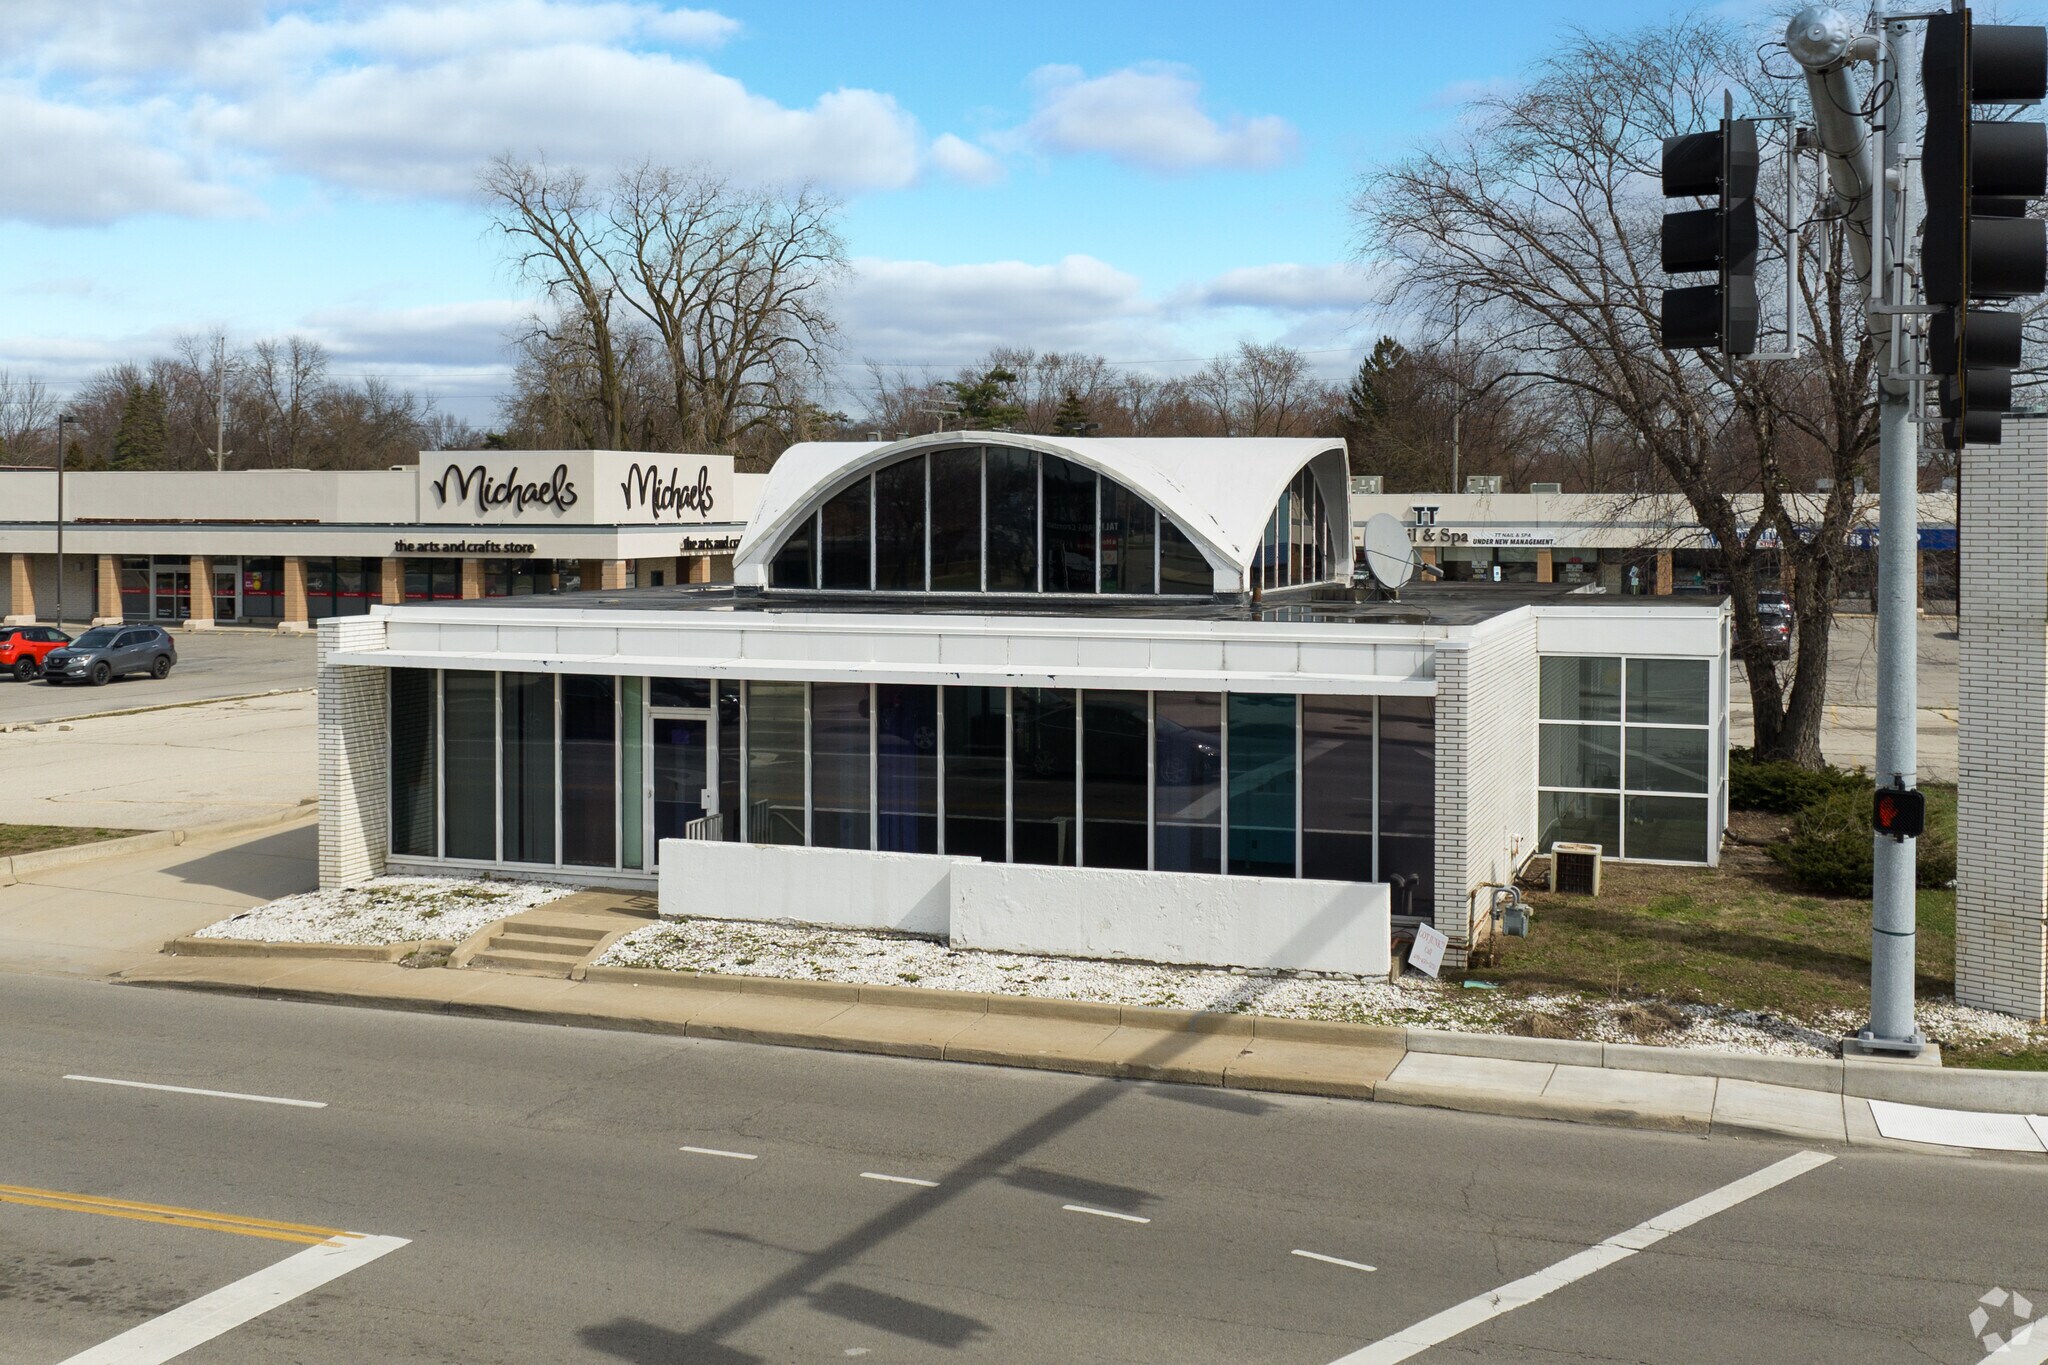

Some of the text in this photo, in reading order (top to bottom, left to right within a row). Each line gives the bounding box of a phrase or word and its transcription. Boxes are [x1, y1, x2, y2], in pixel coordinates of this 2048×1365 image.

[433, 463, 578, 513] Michaels
[620, 463, 714, 519] Michaels
[1411, 505, 1440, 526] TT
[394, 540, 535, 553] the arts and crafts store
[683, 536, 697, 550] the
[698, 538, 713, 550] arts
[714, 535, 729, 549] and
[1423, 528, 1435, 542] &
[1440, 528, 1469, 546] Spa
